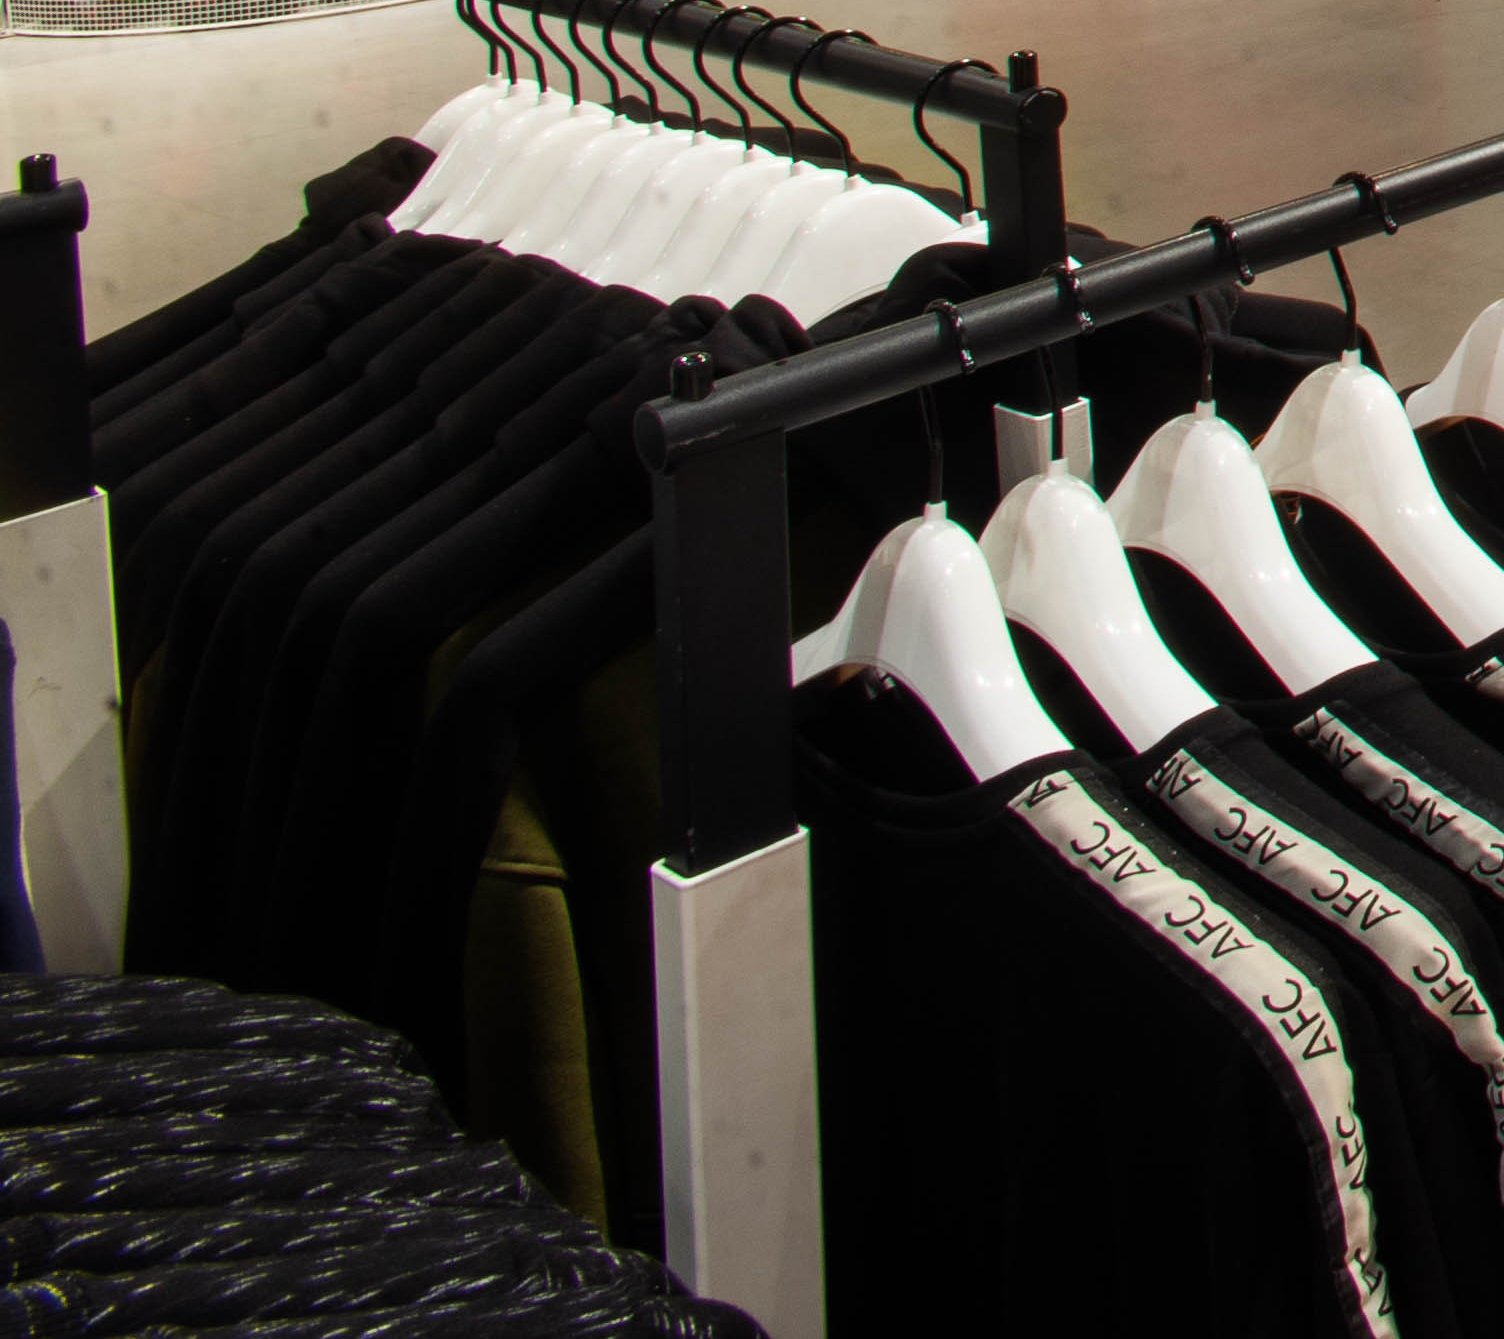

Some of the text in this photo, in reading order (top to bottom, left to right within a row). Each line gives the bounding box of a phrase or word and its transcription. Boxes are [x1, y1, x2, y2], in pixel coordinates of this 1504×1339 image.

[1069, 820, 1337, 1061] AFC AFC
[1213, 806, 1488, 1021] AFC AFC
